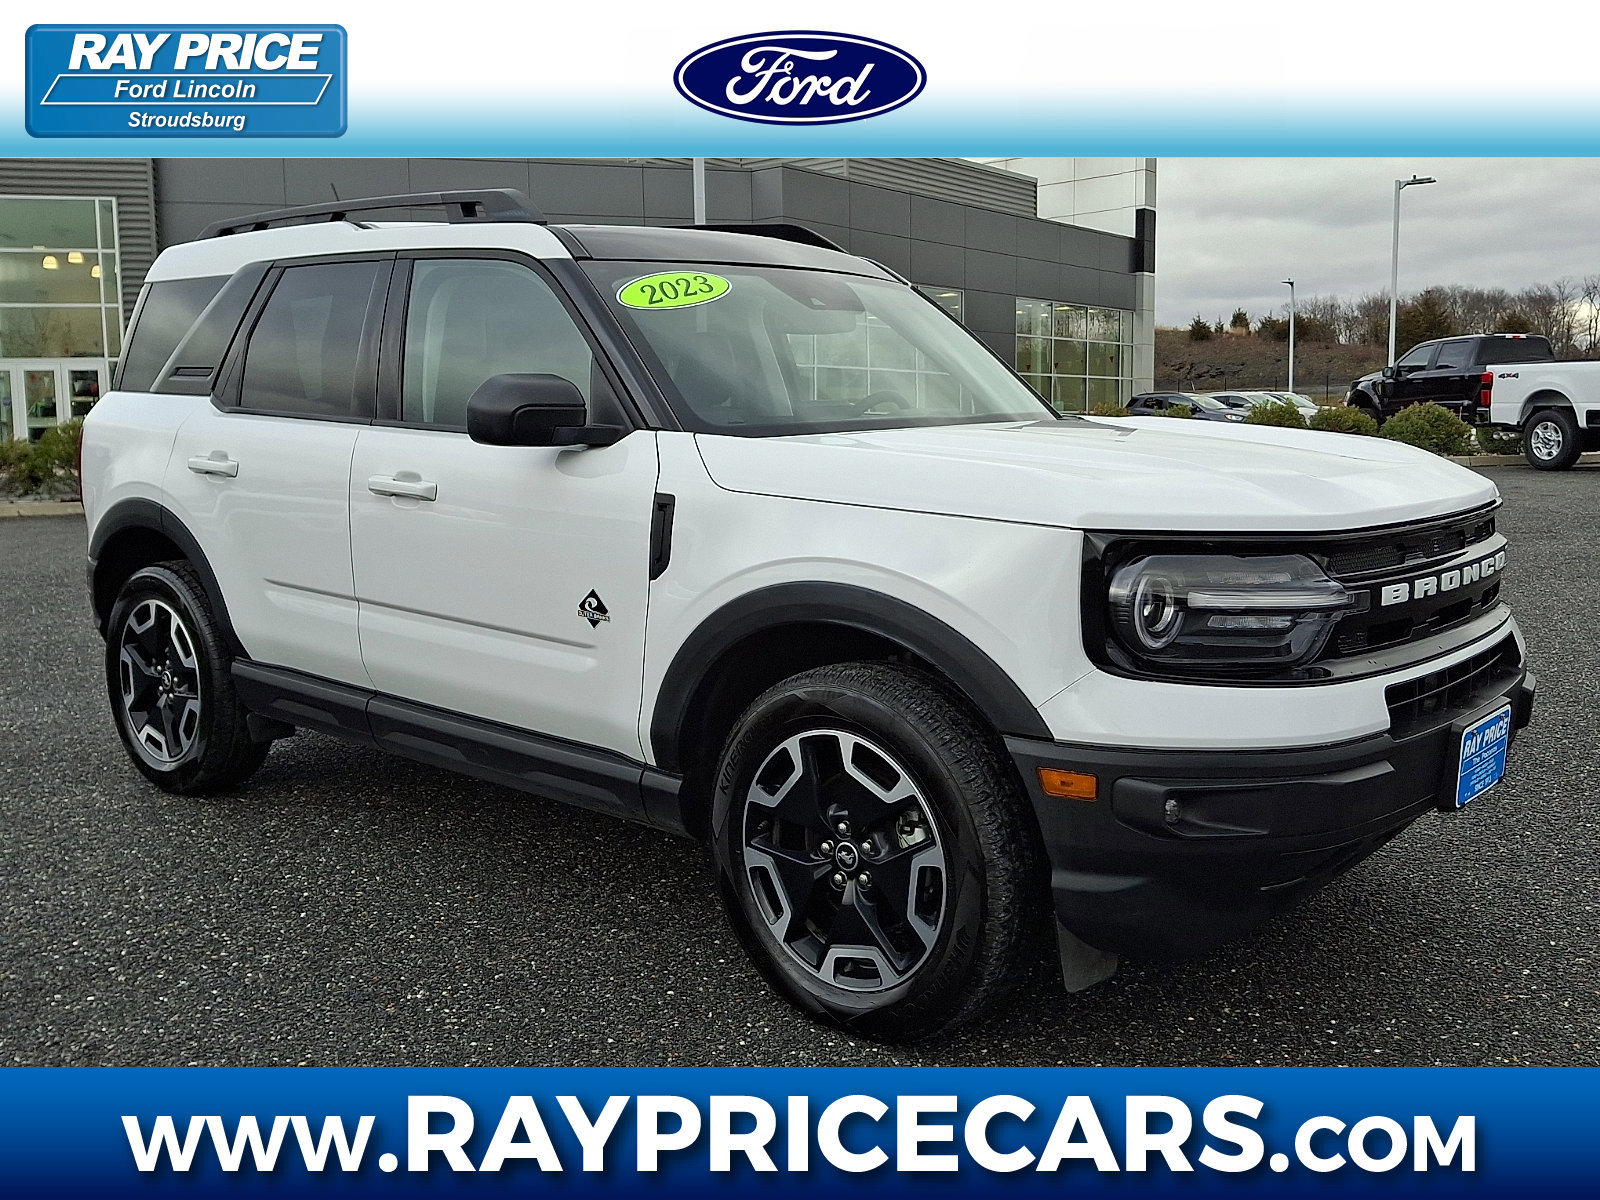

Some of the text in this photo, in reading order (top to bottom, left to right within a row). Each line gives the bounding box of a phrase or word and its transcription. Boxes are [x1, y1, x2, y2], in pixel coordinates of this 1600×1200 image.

[639, 275, 714, 305] 2023
[1381, 551, 1507, 606] BRONCO
[1463, 718, 1508, 760] RAY PRICE
